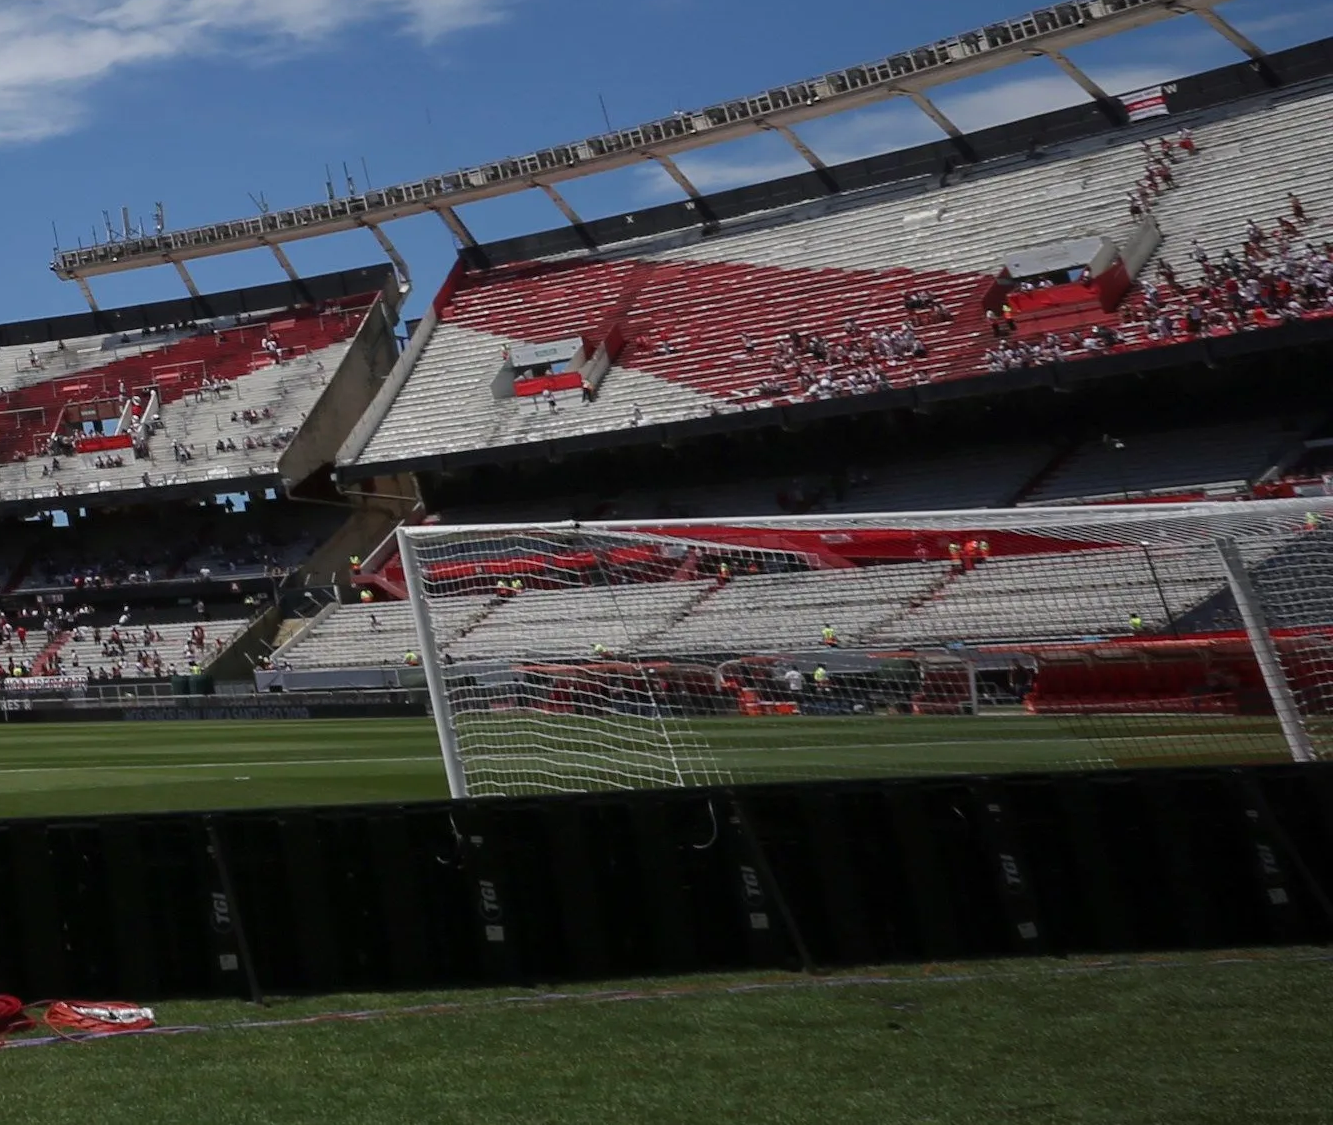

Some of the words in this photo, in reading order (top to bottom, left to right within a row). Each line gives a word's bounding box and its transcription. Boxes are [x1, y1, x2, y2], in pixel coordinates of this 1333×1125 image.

[626, 214, 635, 224] X
[740, 865, 760, 897] TGI
[999, 852, 1021, 885] TGI
[211, 891, 230, 924] TGI
[478, 879, 499, 912] TGI
